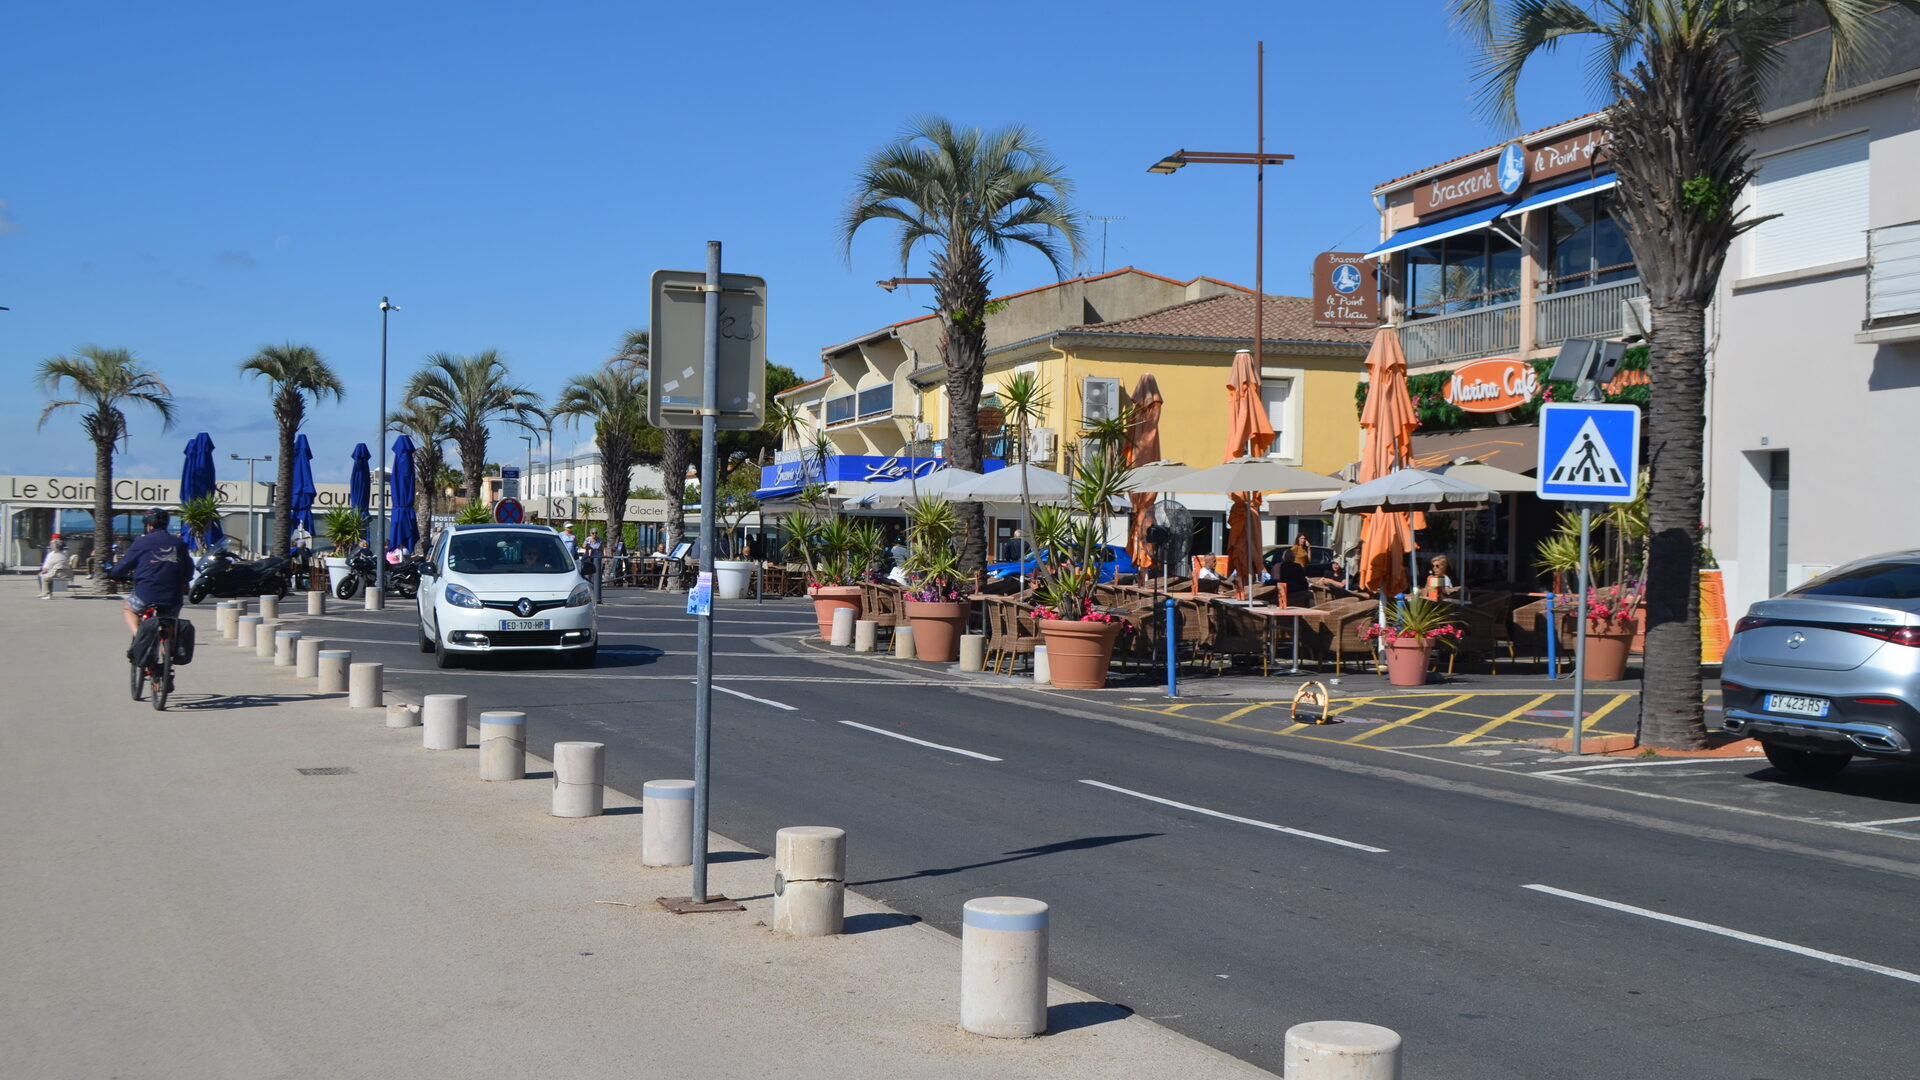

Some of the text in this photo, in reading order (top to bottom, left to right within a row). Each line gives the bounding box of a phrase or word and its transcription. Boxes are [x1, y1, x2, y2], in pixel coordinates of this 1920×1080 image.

[1534, 151, 1546, 173] le
[1544, 140, 1581, 168] Point
[1429, 166, 1493, 208] Brasserie
[1328, 253, 1365, 264] Brasserie
[1323, 305, 1336, 318] de
[1335, 293, 1365, 306] Point
[1450, 366, 1538, 402] Marina Café
[863, 457, 910, 482] Les
[11, 477, 170, 501] Le Sain Clair
[629, 504, 664, 516] Glacier
